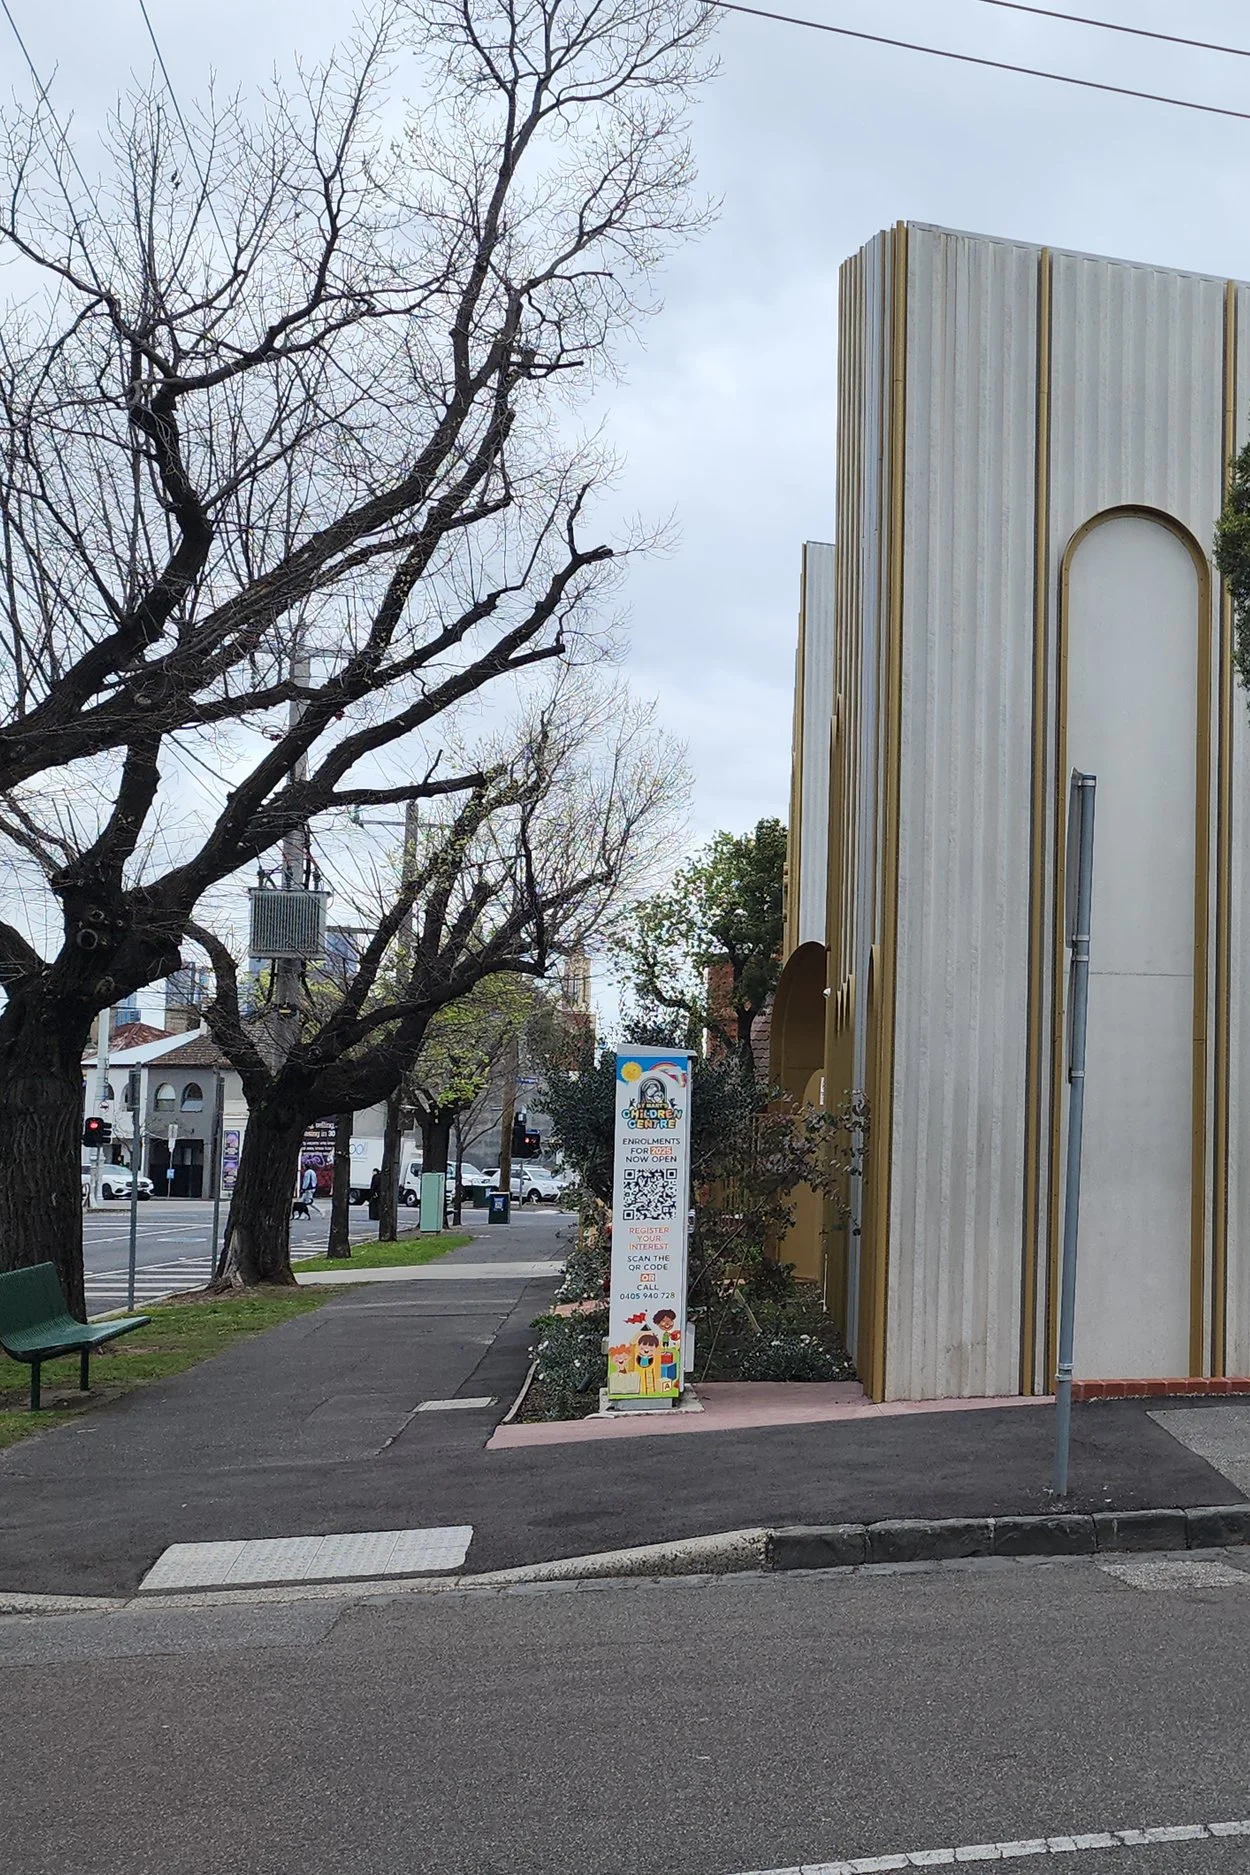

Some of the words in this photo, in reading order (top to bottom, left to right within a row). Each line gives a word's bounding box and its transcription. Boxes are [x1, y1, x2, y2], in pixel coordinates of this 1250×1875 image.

[628, 1119, 676, 1129] CENTRE
[630, 1147, 649, 1155] FOR
[628, 1263, 642, 1271] QR
[644, 1263, 668, 1271] CODE
